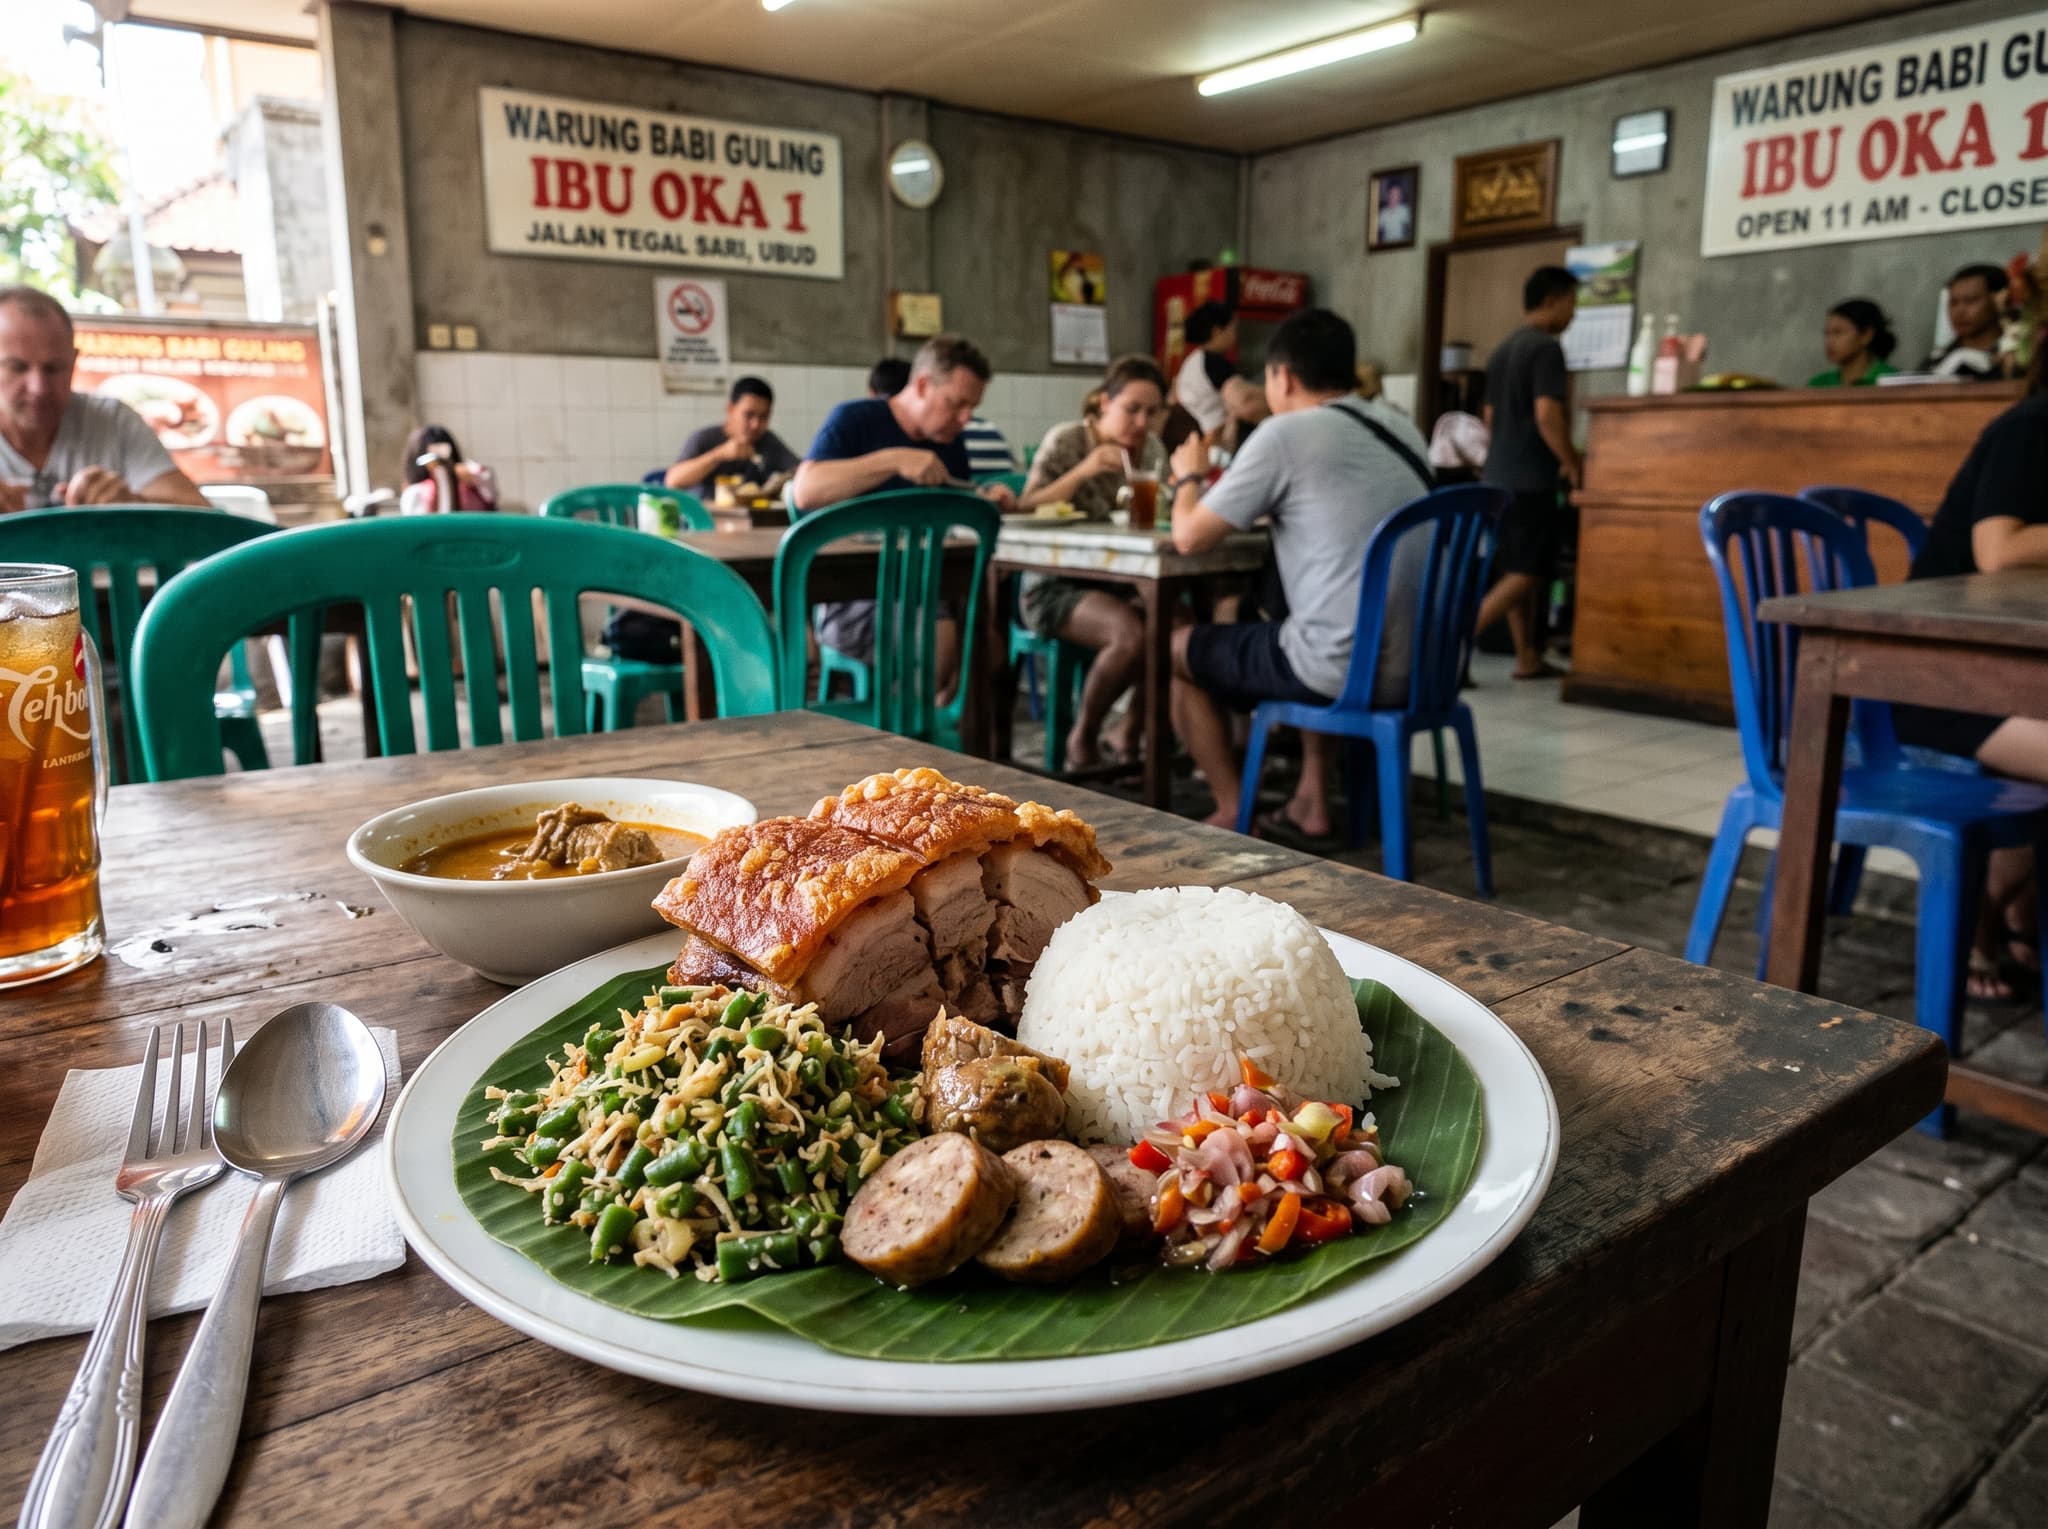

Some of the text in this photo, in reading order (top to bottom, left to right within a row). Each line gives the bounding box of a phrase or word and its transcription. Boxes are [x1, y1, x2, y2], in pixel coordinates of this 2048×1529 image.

[1732, 62, 1882, 128] WARUNG
[1895, 41, 1988, 100] BABI
[505, 103, 824, 176] WARUNG BABI GULING
[1740, 126, 1844, 200] IBU
[1857, 101, 1996, 182] OKA
[530, 156, 808, 233] IBU OKA 1
[1737, 210, 1810, 240] OPEN
[1821, 203, 1850, 230] 11
[1863, 195, 1909, 226] AM
[1940, 178, 2048, 216] CLOSE
[527, 222, 817, 265] JALAN TEGAL SARI, UBUD
